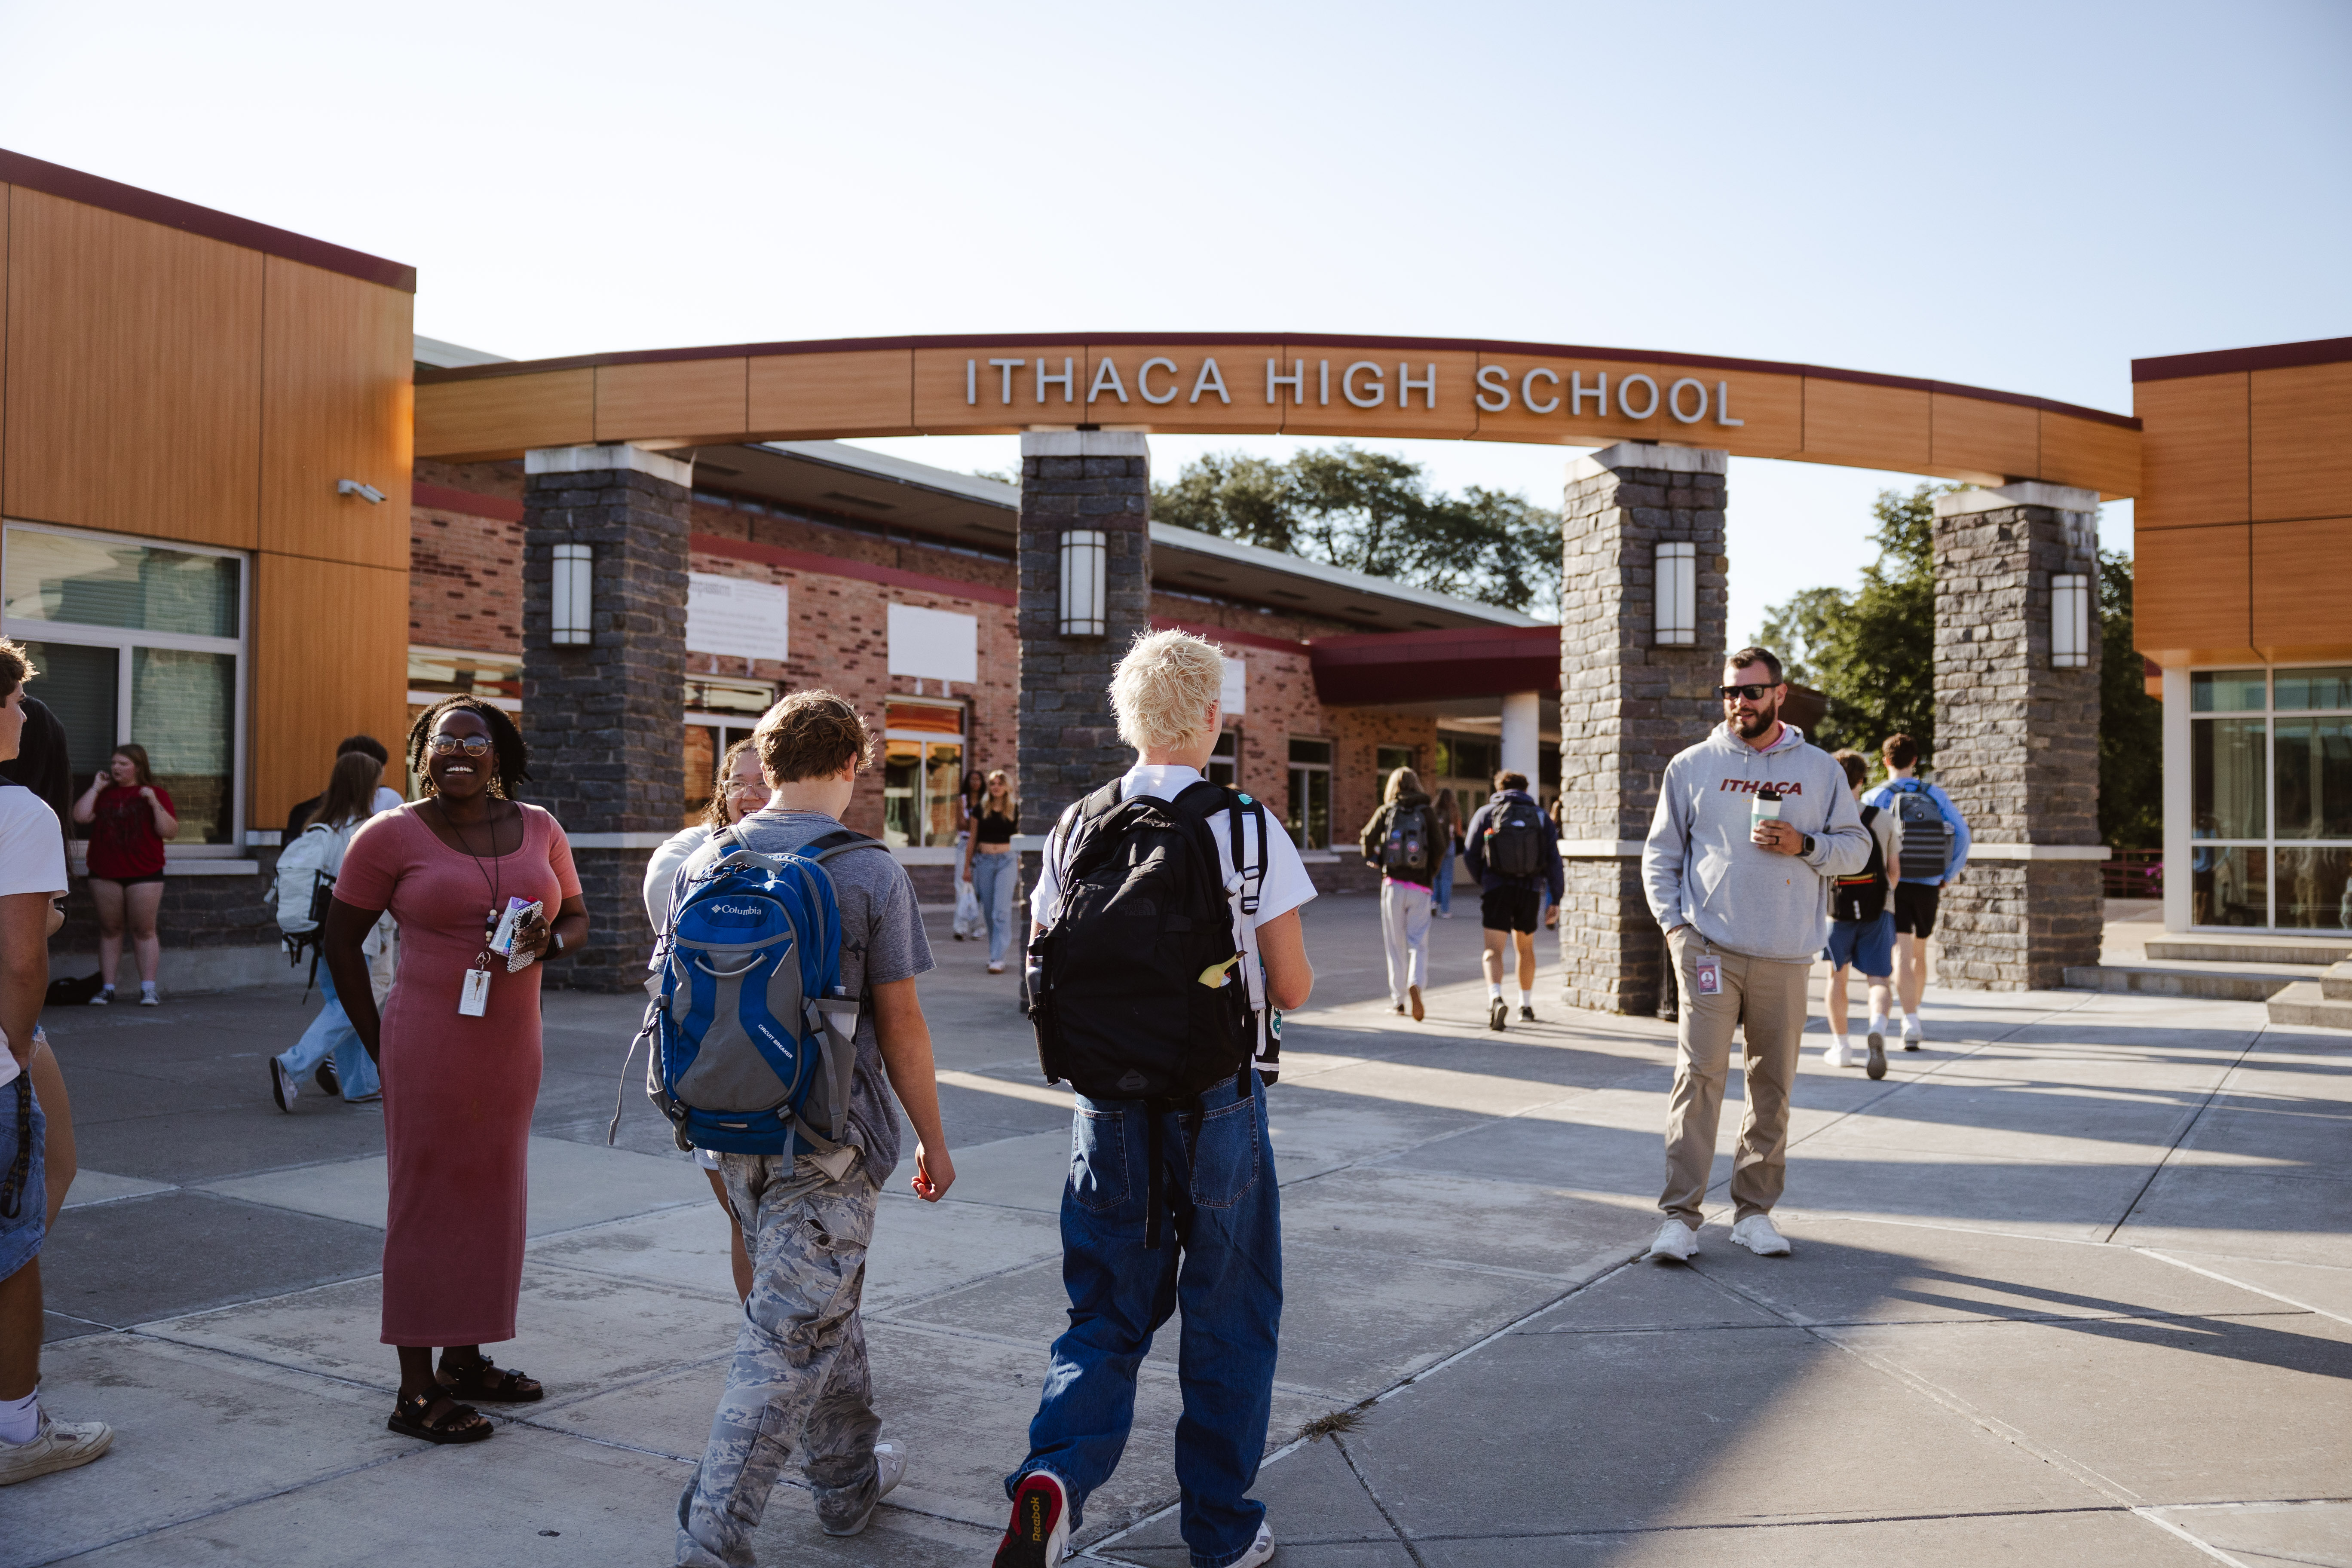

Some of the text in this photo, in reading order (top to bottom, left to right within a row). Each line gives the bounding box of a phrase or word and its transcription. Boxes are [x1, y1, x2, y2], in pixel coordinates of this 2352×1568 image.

[967, 357, 1744, 426] ITHACA HIGH SCHOOL
[1720, 779, 1802, 795] ITHACA
[722, 905, 761, 915] Columbia
[758, 1024, 793, 1059] CIRCUIT BREAKER
[1031, 1497, 1041, 1541] Reebok
